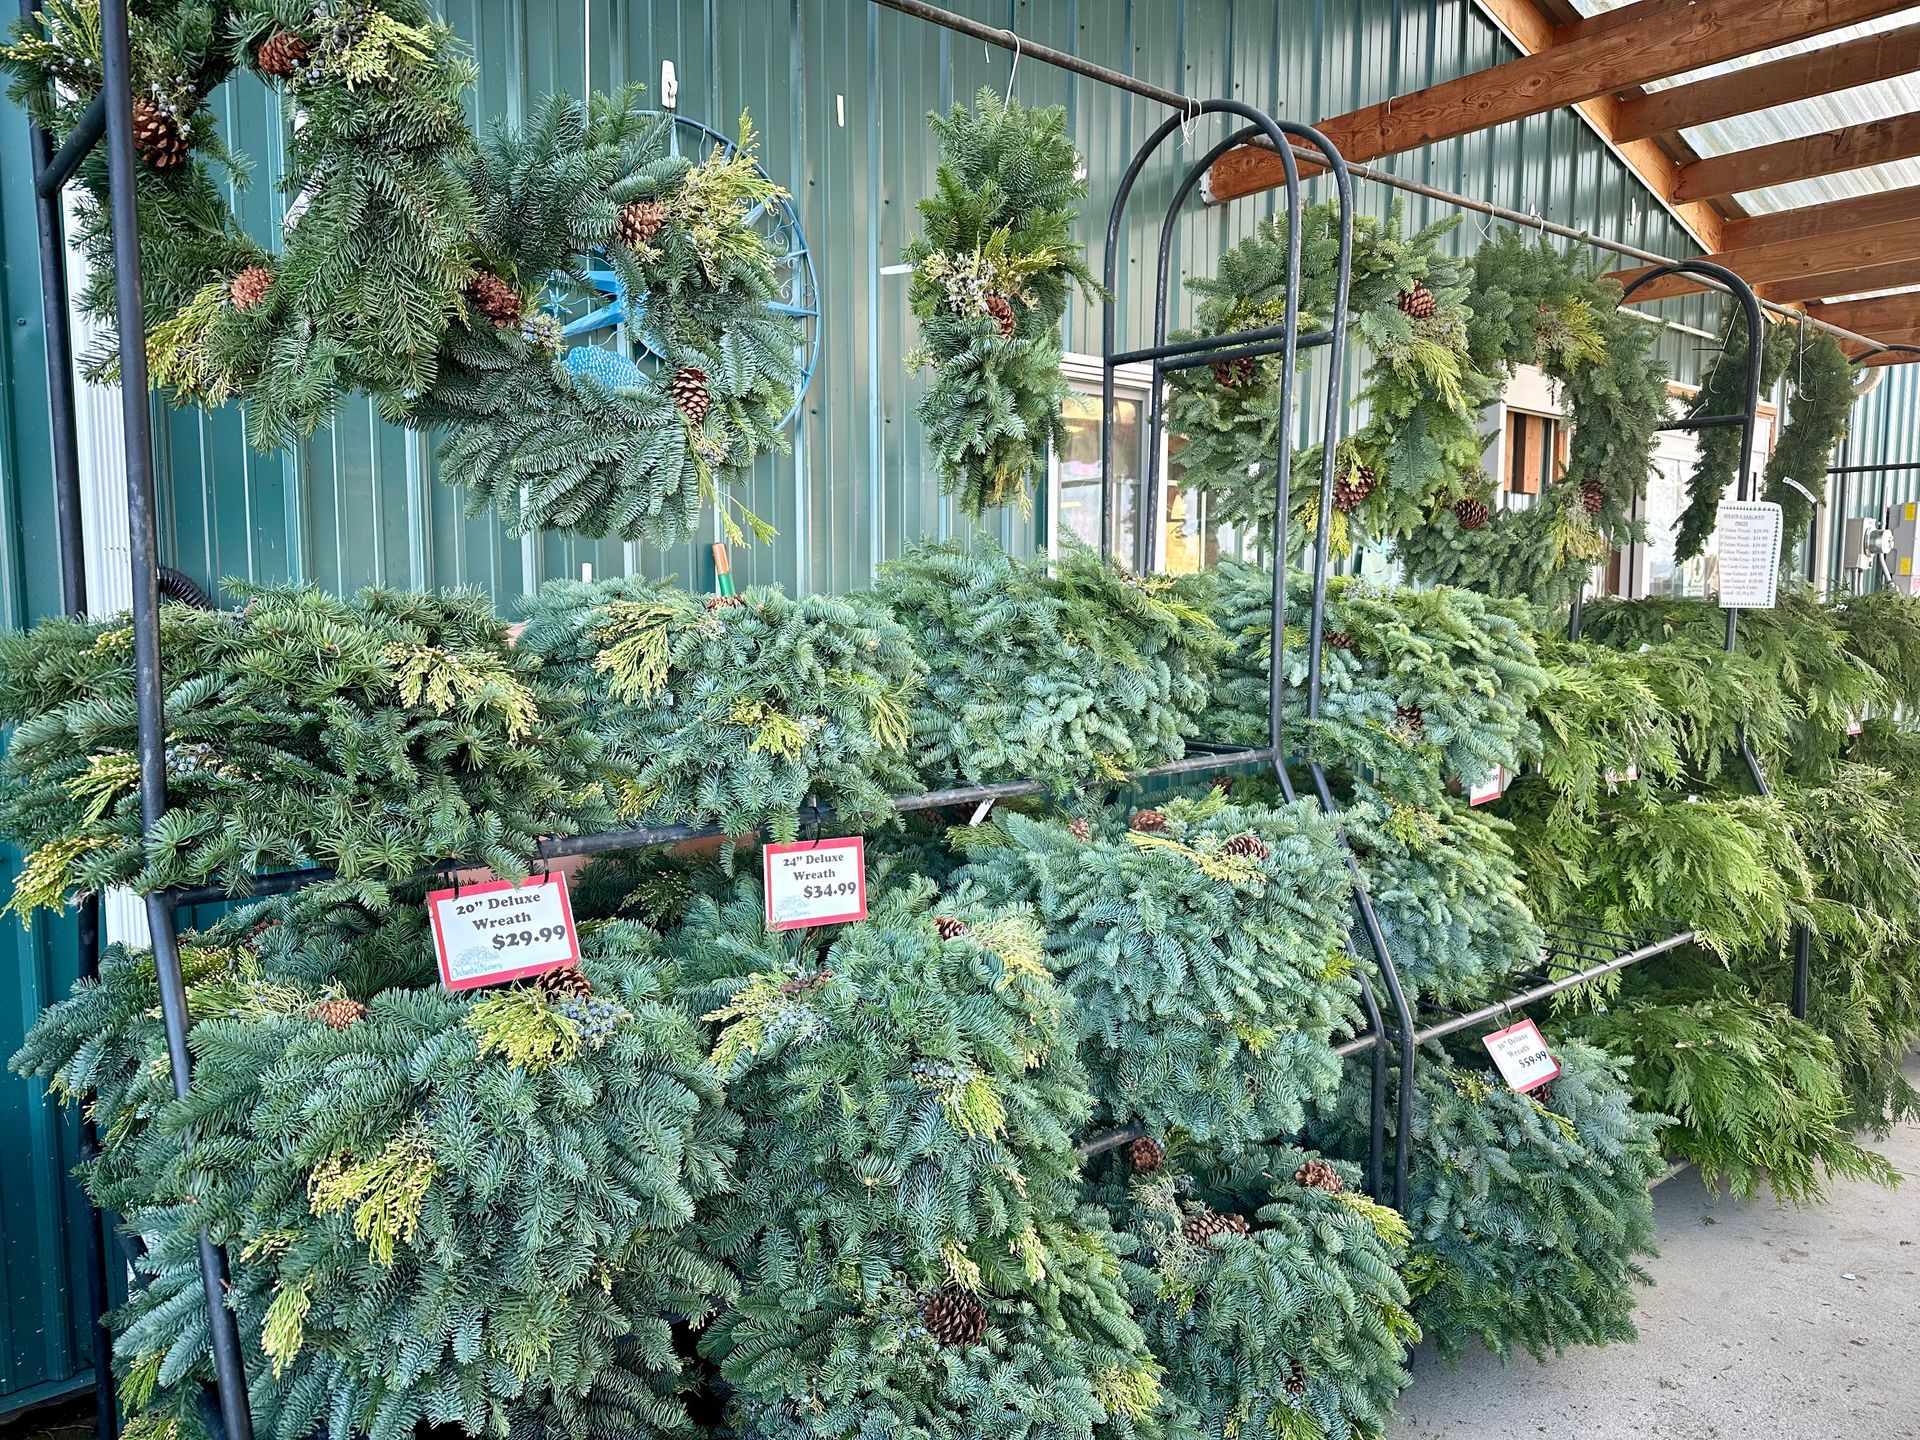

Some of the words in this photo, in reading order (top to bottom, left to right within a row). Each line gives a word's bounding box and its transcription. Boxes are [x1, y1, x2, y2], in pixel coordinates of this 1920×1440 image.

[783, 856, 802, 866] 24"
[806, 854, 844, 864] Deluxe
[794, 869, 836, 880] Wreath
[804, 882, 856, 899] $34.99
[456, 900, 482, 916] 20"
[488, 894, 541, 910] Deluxe
[472, 912, 532, 930] Wreath
[492, 925, 566, 950] $29.99
[1507, 1034, 1528, 1046] Deluxe
[1506, 1044, 1530, 1058] Wreath
